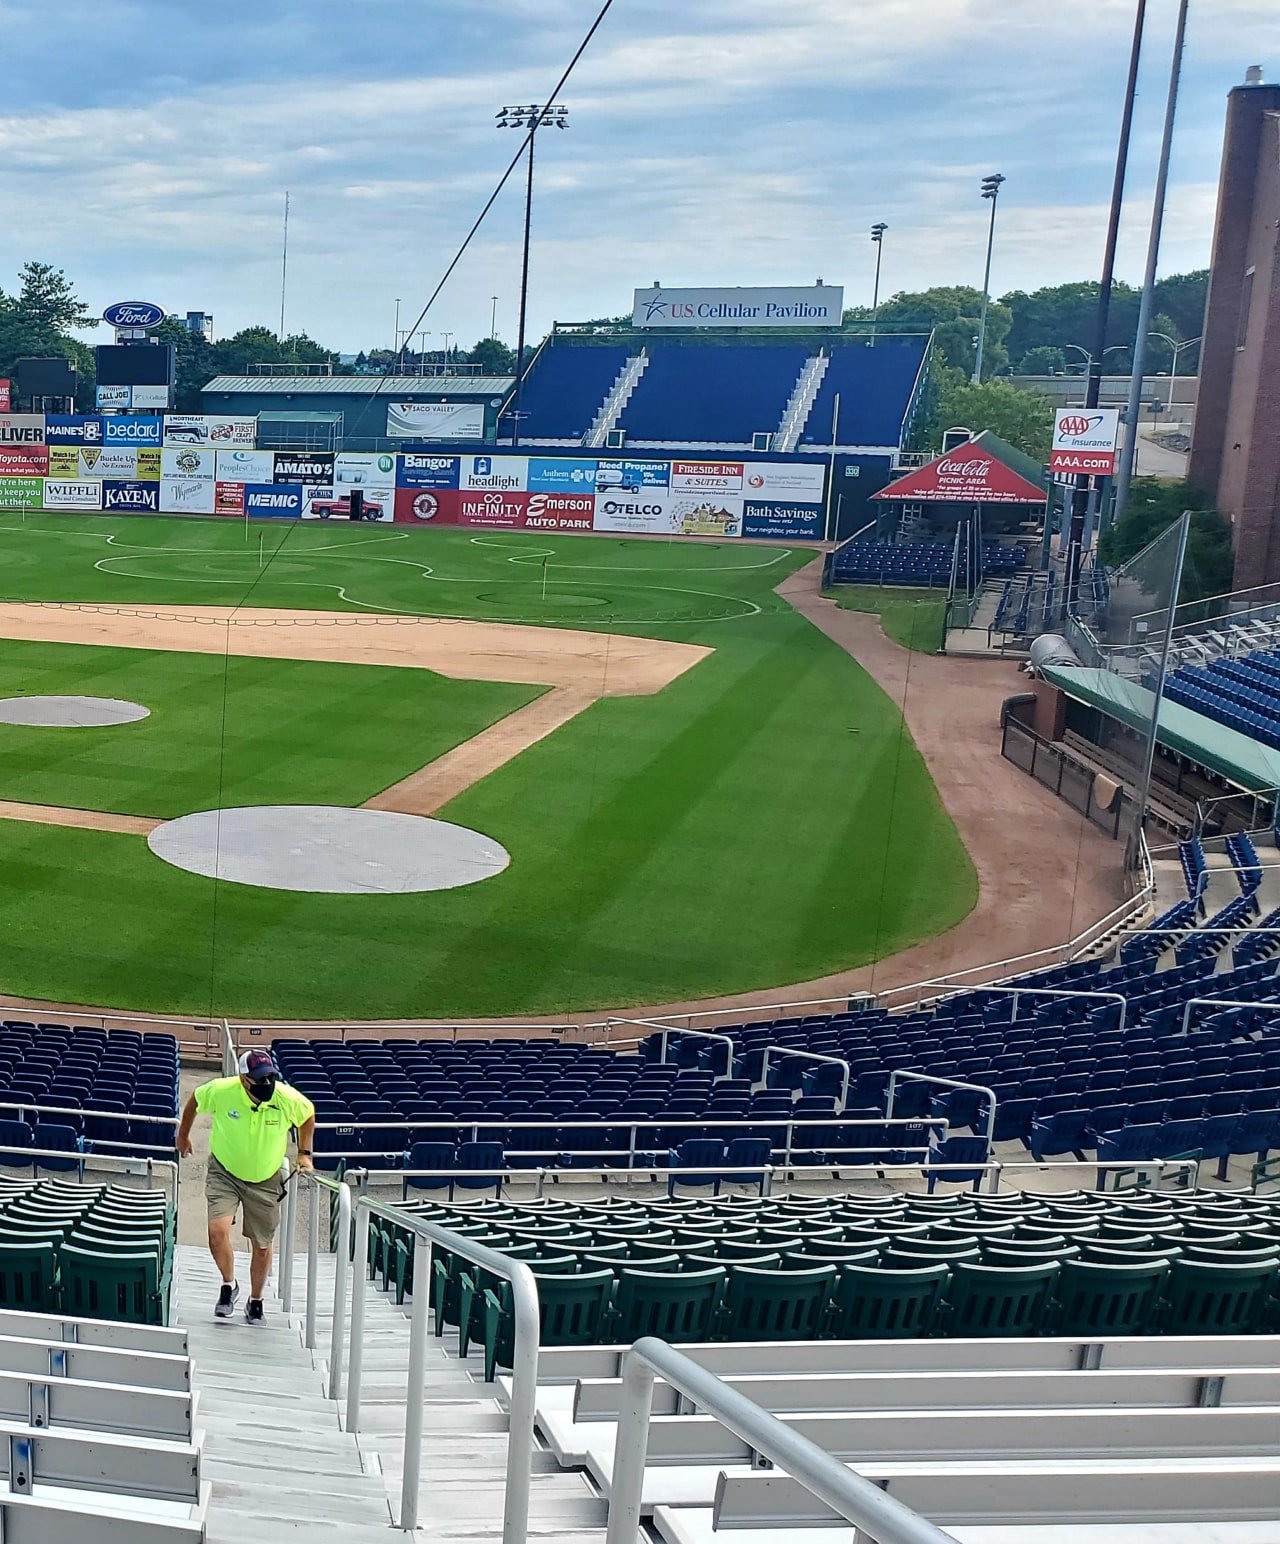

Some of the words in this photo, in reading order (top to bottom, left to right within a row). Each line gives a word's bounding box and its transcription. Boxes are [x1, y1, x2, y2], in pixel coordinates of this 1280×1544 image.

[115, 306, 152, 324] Ford
[671, 303, 695, 318] U.S.
[697, 303, 760, 318] Cellular
[765, 302, 828, 318] Pavilion
[98, 392, 114, 400] CALL
[106, 420, 160, 438] bedard
[234, 425, 254, 433] FIRST
[1071, 439, 1112, 447] Insurance
[380, 459, 391, 468] ON
[404, 455, 454, 471] Bangor
[599, 461, 623, 470] Need
[625, 462, 669, 472] Propane?
[936, 458, 994, 476] Coca-Cola
[1053, 455, 1110, 468] AAA.com
[274, 462, 333, 475] AMATO'S
[402, 468, 433, 476] Savings
[541, 469, 569, 478] Anthem
[678, 464, 719, 475] FIRESIDE
[721, 464, 738, 475] INN
[468, 474, 519, 490] headlight
[642, 477, 668, 485] deliver.
[685, 478, 691, 486] &
[693, 478, 728, 487] SUITES
[965, 477, 986, 485] AREA
[4, 488, 24, 497] keep
[25, 490, 41, 498] you
[104, 488, 157, 509] KAYEM
[8, 498, 33, 506] there.
[247, 493, 299, 509] MEMIC
[526, 494, 592, 517] Emerson
[462, 502, 524, 516] INFINITY
[746, 505, 772, 518] Bath
[774, 506, 818, 522] Savings
[525, 518, 557, 527] AUTO
[559, 519, 591, 529] PARK
[745, 526, 758, 534] Your
[785, 528, 800, 536] your
[800, 527, 816, 536] bank.
